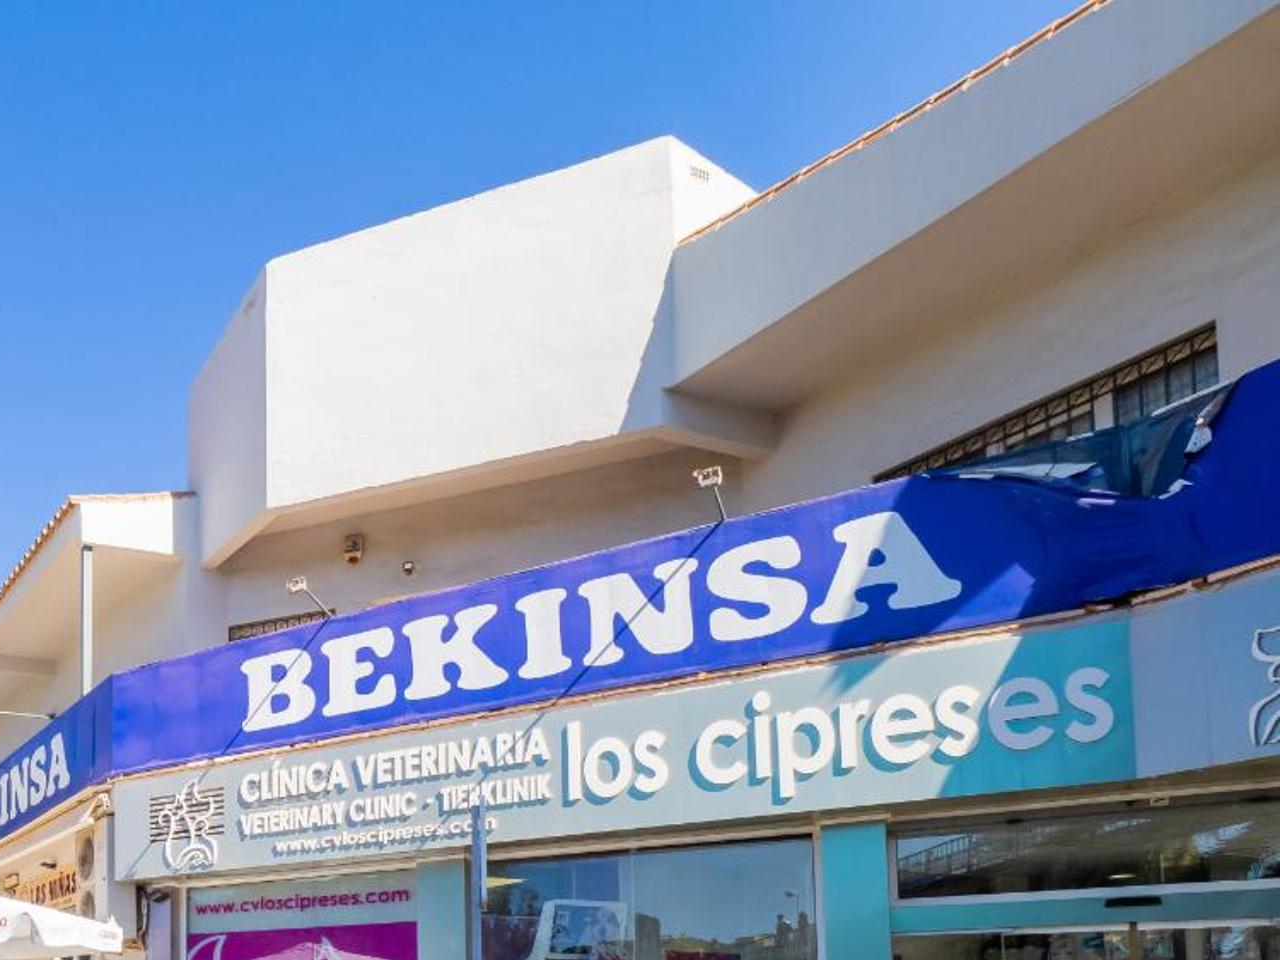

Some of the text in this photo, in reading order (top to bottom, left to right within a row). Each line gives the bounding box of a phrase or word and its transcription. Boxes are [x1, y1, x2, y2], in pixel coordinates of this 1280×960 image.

[240, 511, 963, 732] BEKINSA
[565, 666, 1115, 802] los cipreses
[240, 760, 349, 803] CLÍNICA
[240, 801, 345, 836] VETERINARY
[348, 791, 418, 822] CLINIC
[439, 772, 554, 812] TIERKLINIK
[195, 889, 410, 915] www.cvloscipreses.com
